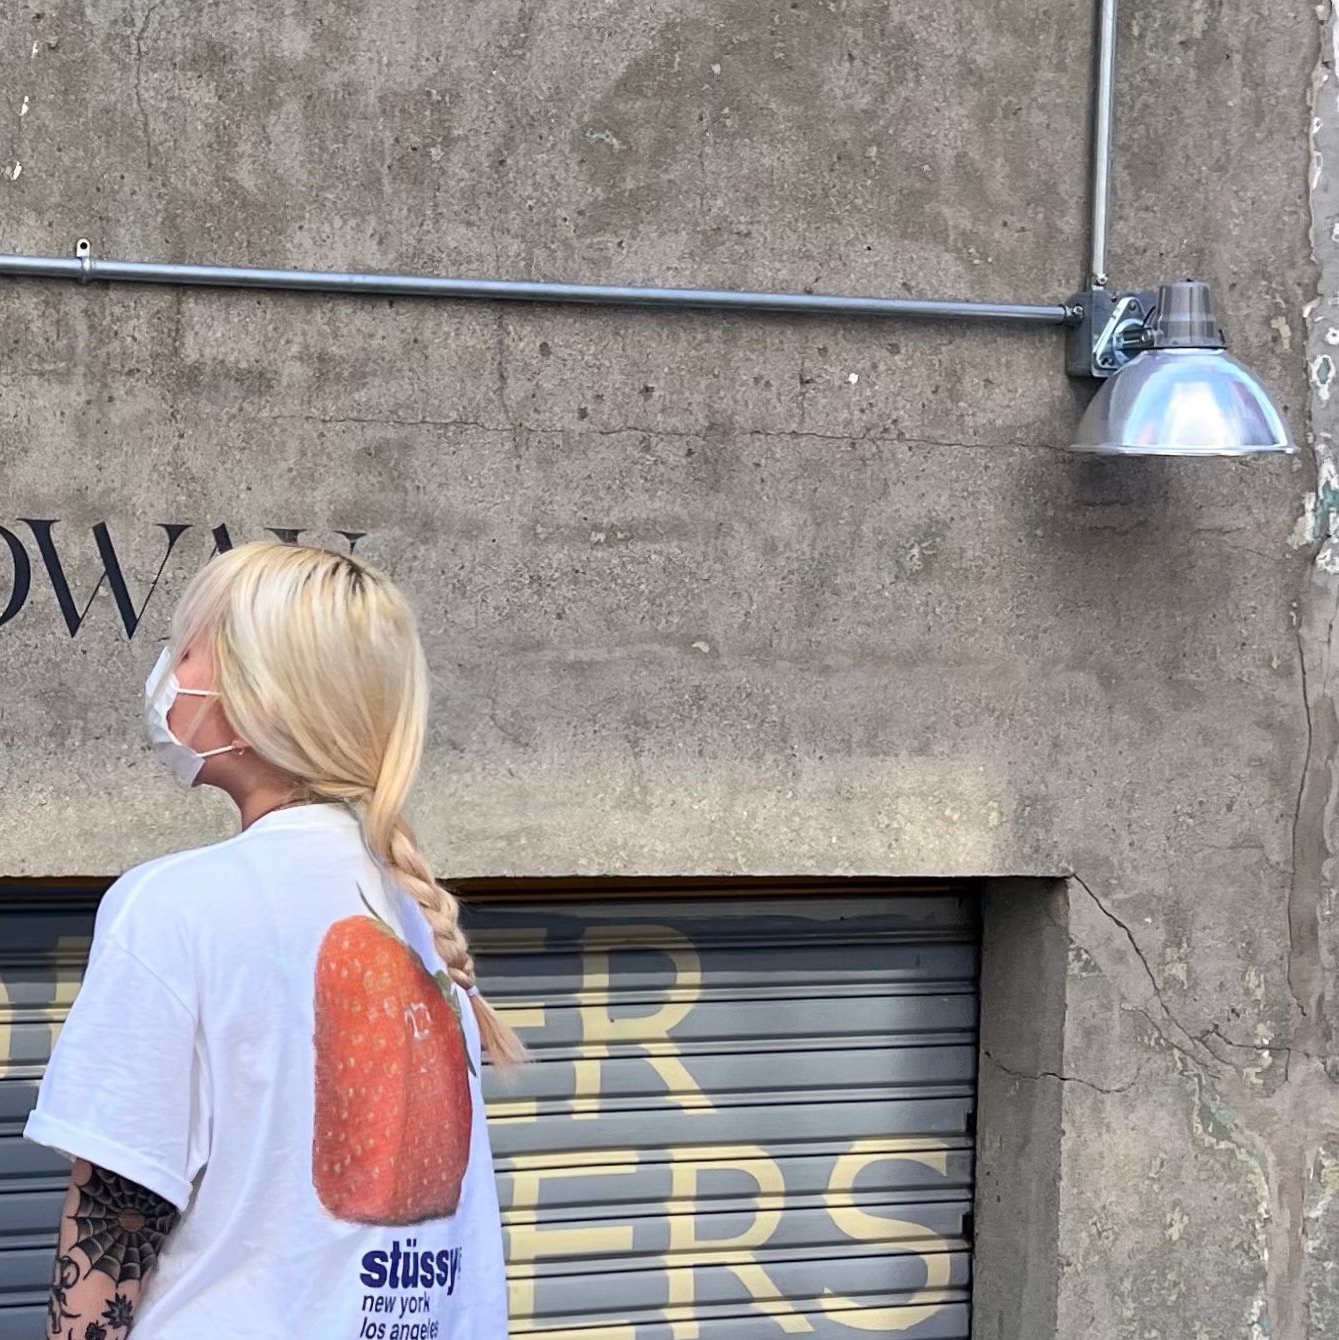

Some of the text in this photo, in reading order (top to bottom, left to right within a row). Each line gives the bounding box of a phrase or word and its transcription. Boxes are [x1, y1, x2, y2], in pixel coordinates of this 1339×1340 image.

[360, 1238, 458, 1296] stüssy
[362, 1291, 430, 1319] new york
[360, 1316, 386, 1340] los
